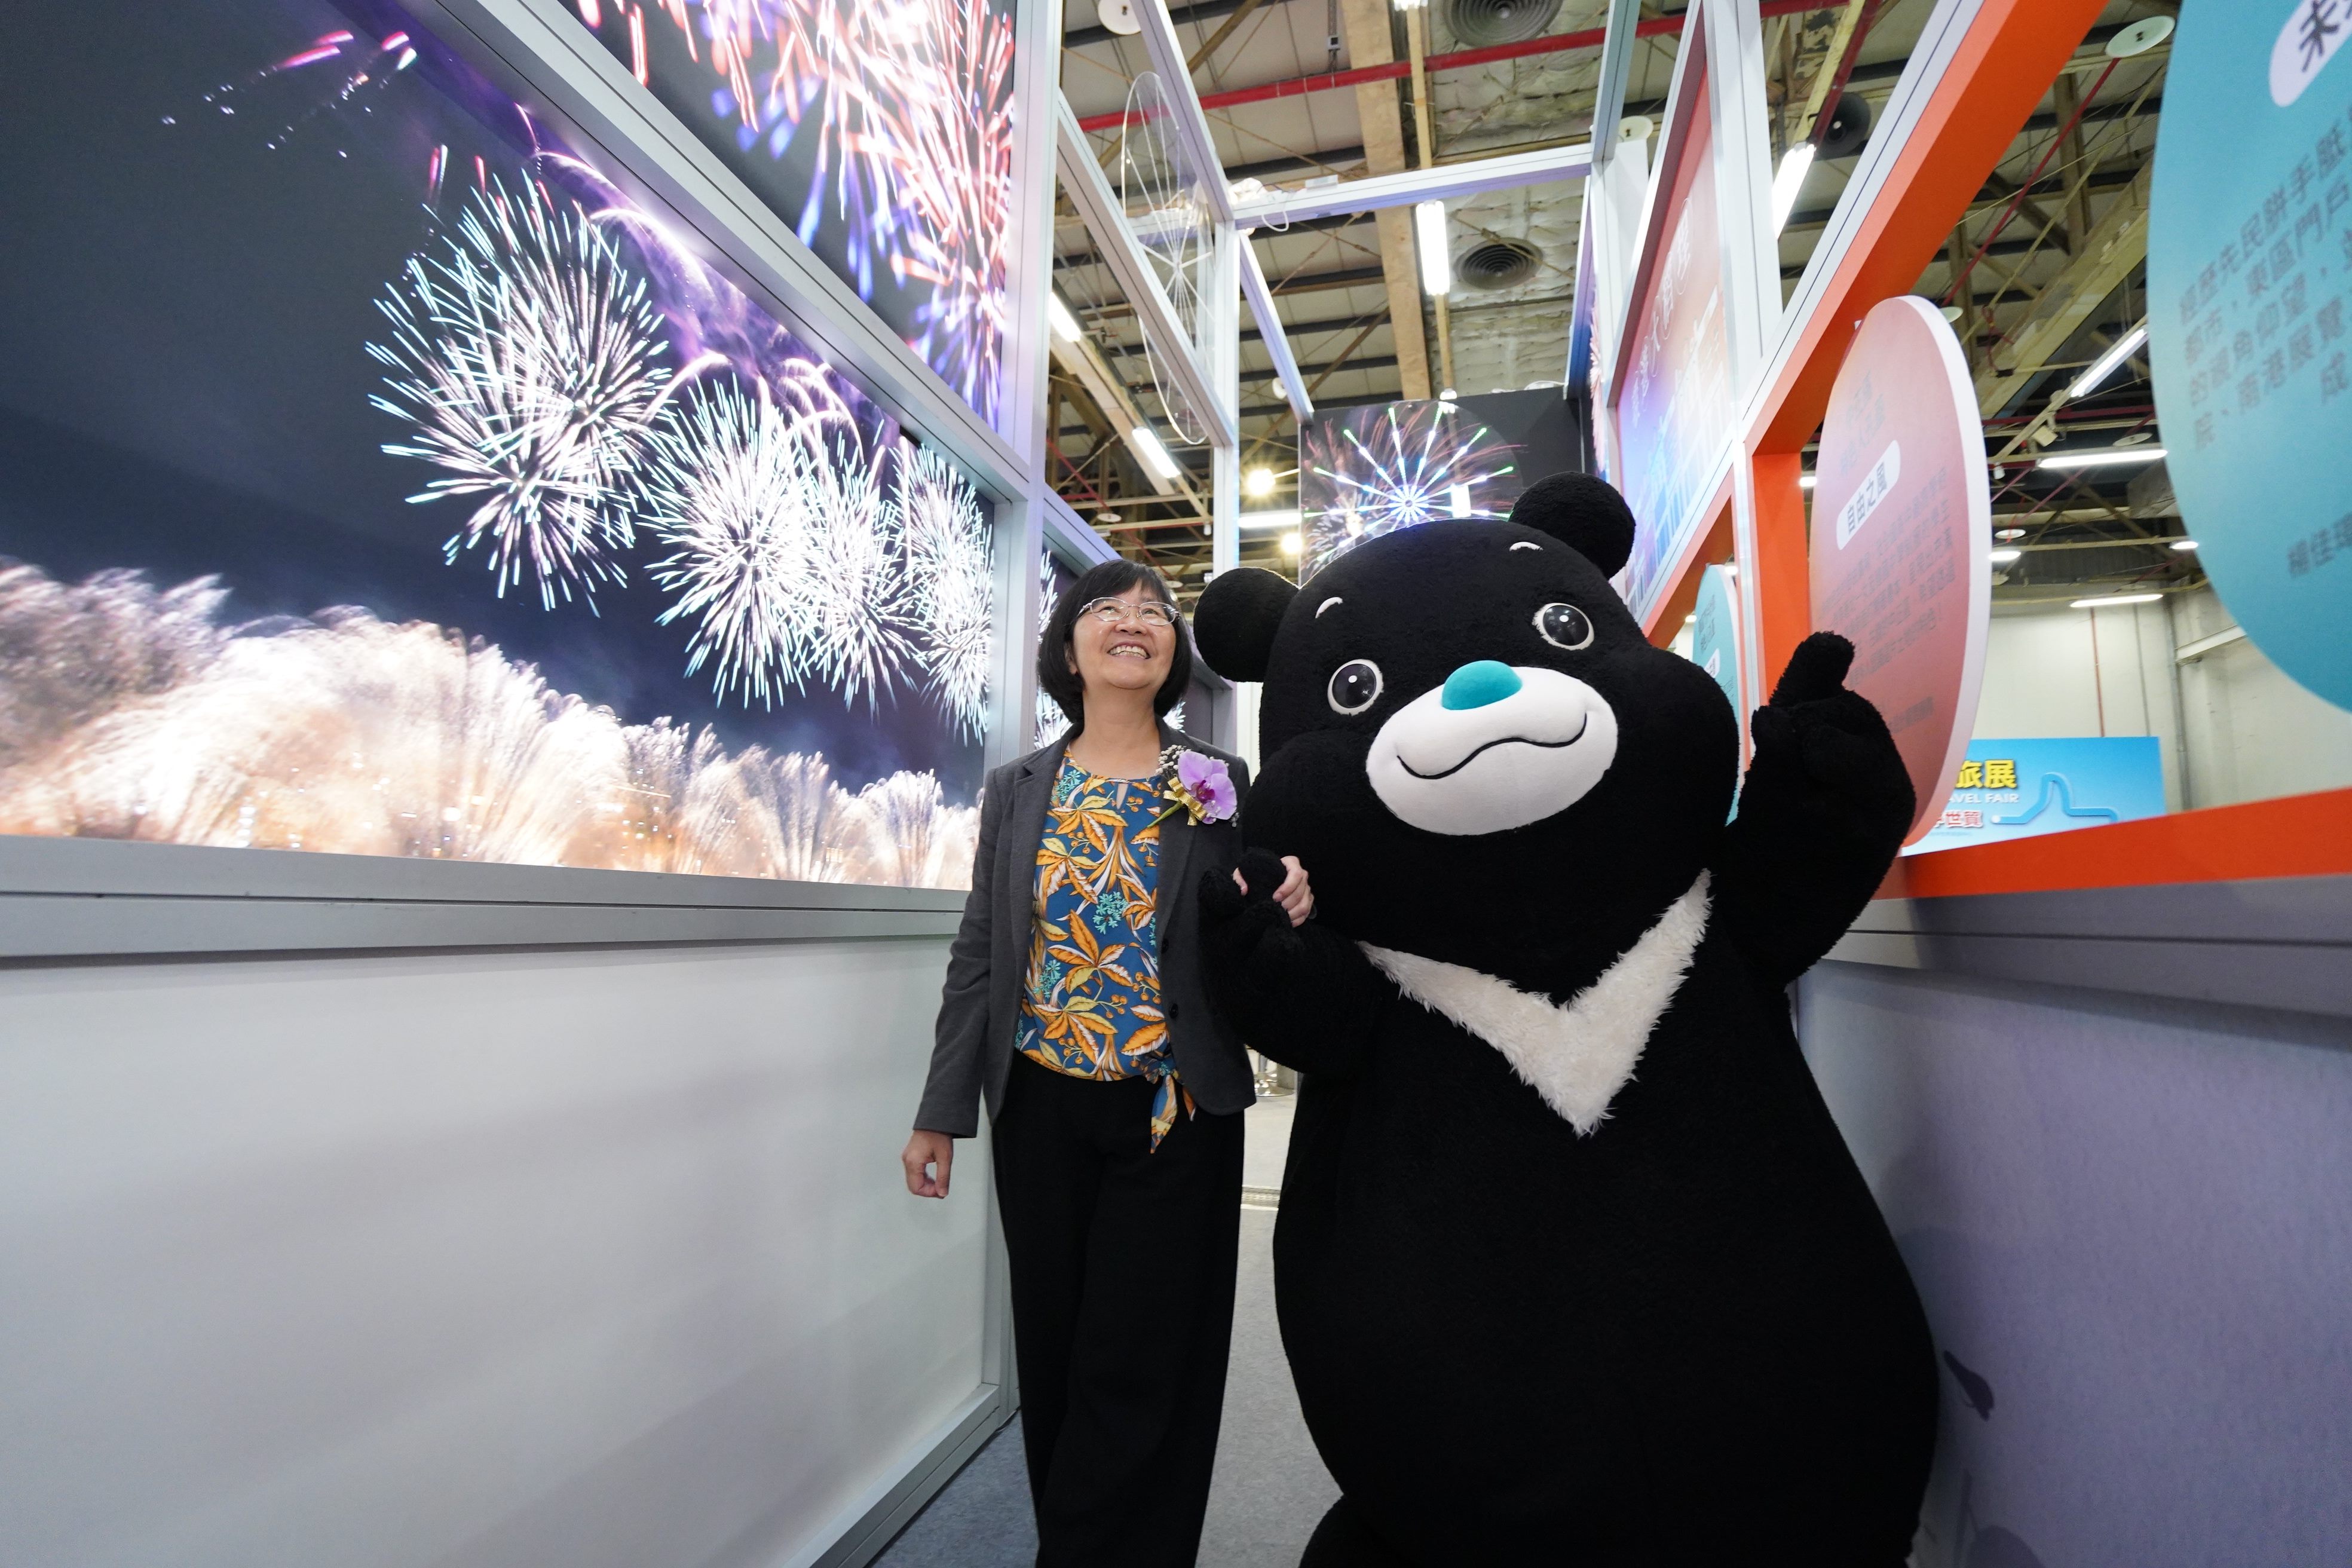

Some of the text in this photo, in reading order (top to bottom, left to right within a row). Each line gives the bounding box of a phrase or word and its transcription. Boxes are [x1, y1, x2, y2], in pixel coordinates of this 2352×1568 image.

[1847, 461, 1887, 534] 自由之風
[1985, 794, 2019, 803] FAIR
[1935, 810, 1983, 828] 世貿
